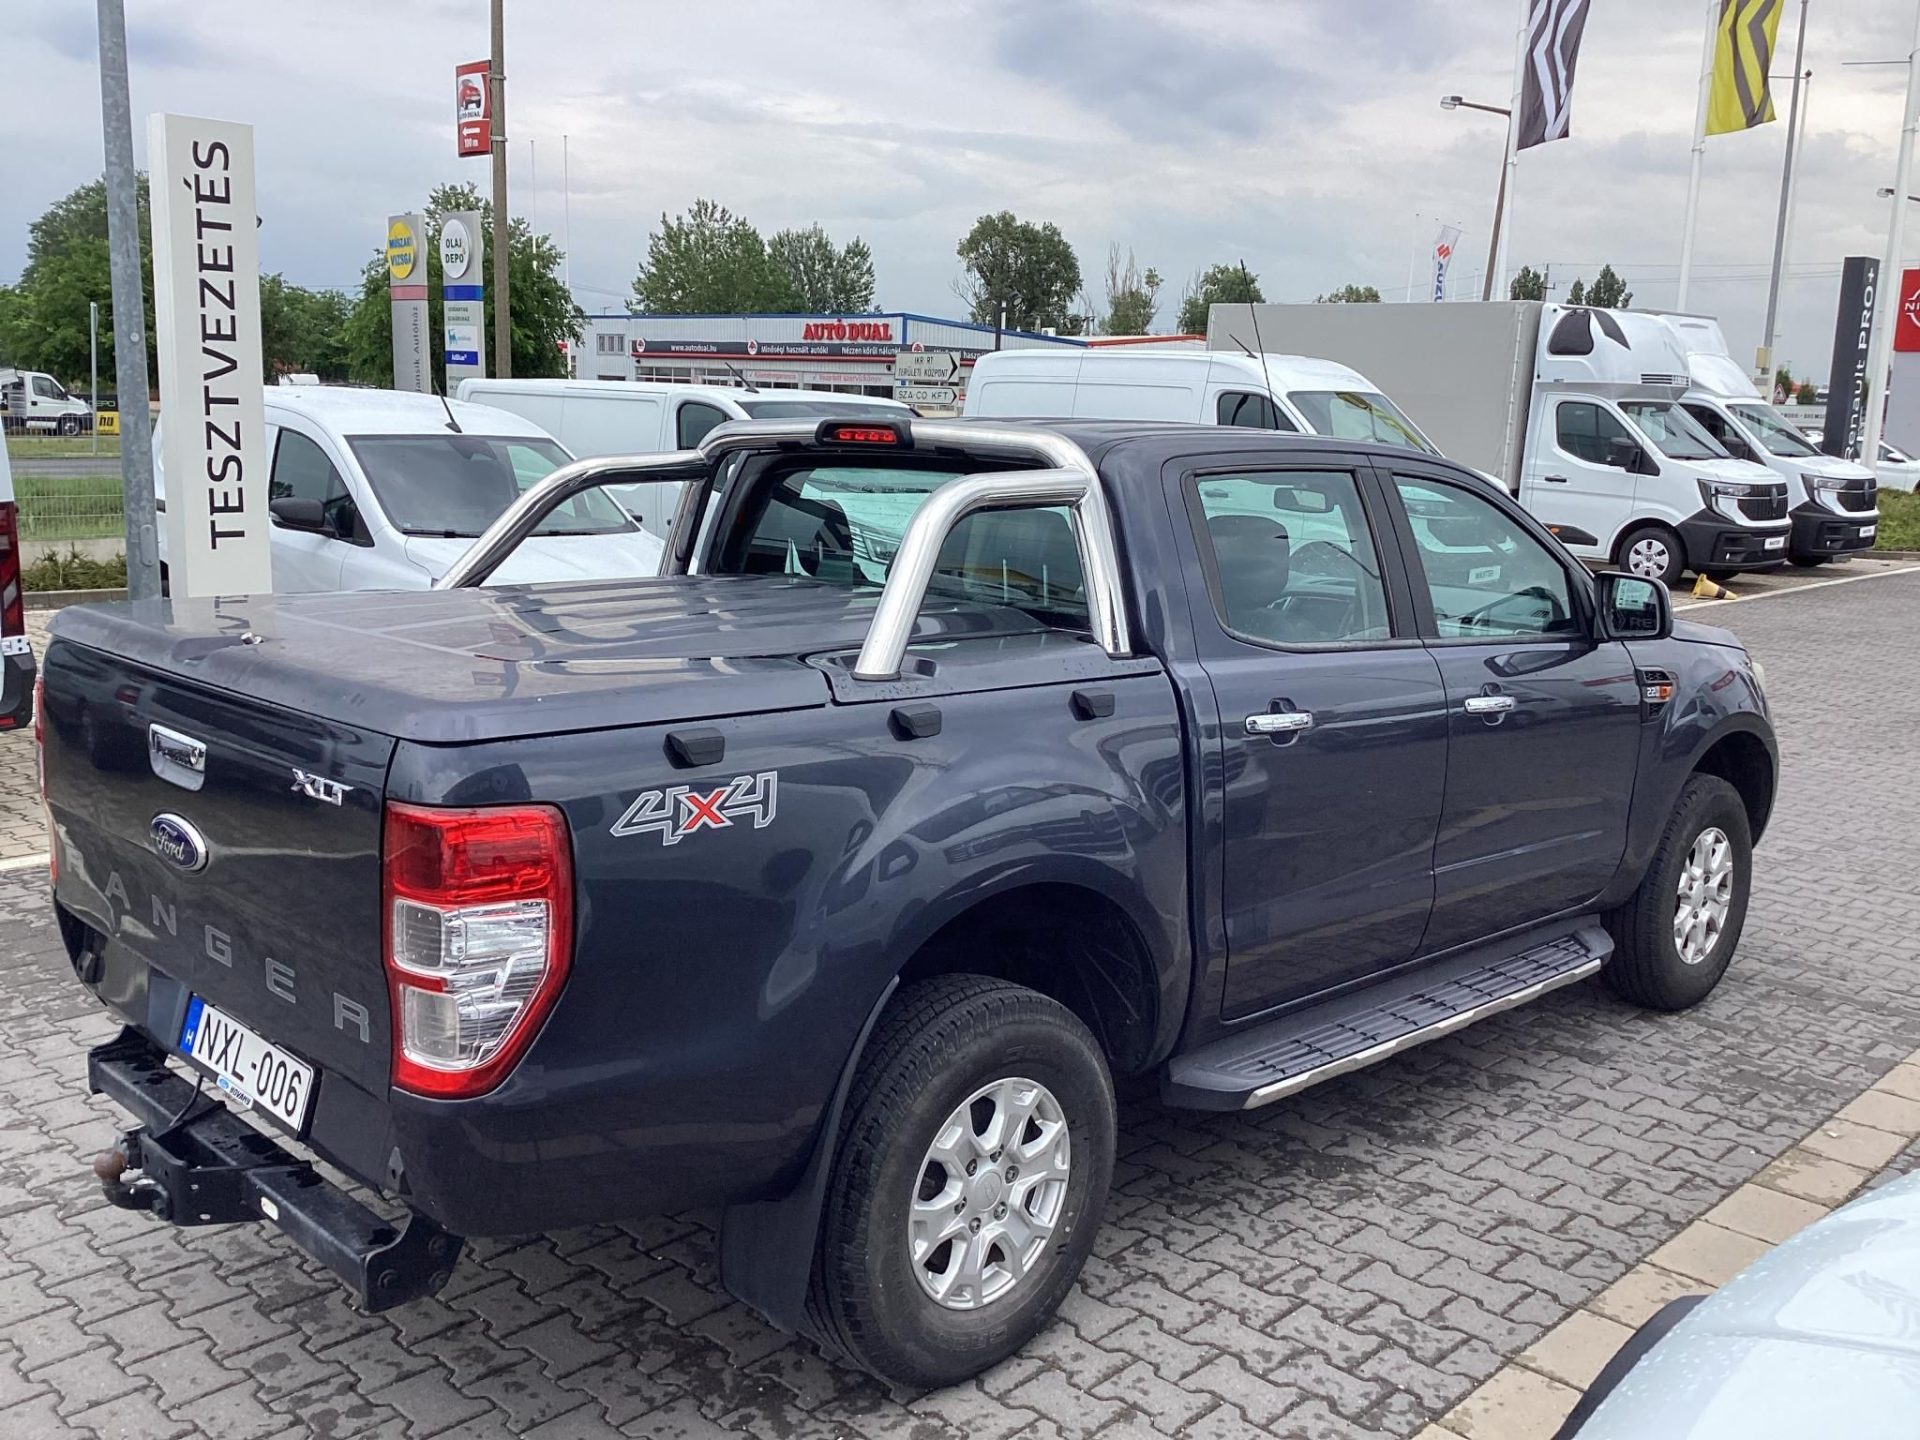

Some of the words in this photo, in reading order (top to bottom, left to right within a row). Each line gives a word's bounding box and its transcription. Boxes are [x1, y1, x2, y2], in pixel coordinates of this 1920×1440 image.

[445, 238, 462, 248] OLAJ
[390, 253, 412, 266] VIZSGA
[803, 318, 847, 341] AUTÓ
[848, 324, 893, 342] DUAL
[183, 140, 245, 550] TESZTVEZETÉS
[670, 344, 718, 353] www.autodual.hu
[841, 346, 863, 355] Nézzen
[898, 367, 922, 377] TERÜLETI
[923, 368, 949, 378] KÖZPONT
[1845, 359, 1866, 460] Renault
[1858, 267, 1875, 350] PRO+
[290, 767, 354, 807] XLT
[156, 823, 186, 861] Ford
[65, 845, 370, 1043] RANGER
[185, 1029, 195, 1046] H
[198, 1012, 302, 1118] NXL-006
